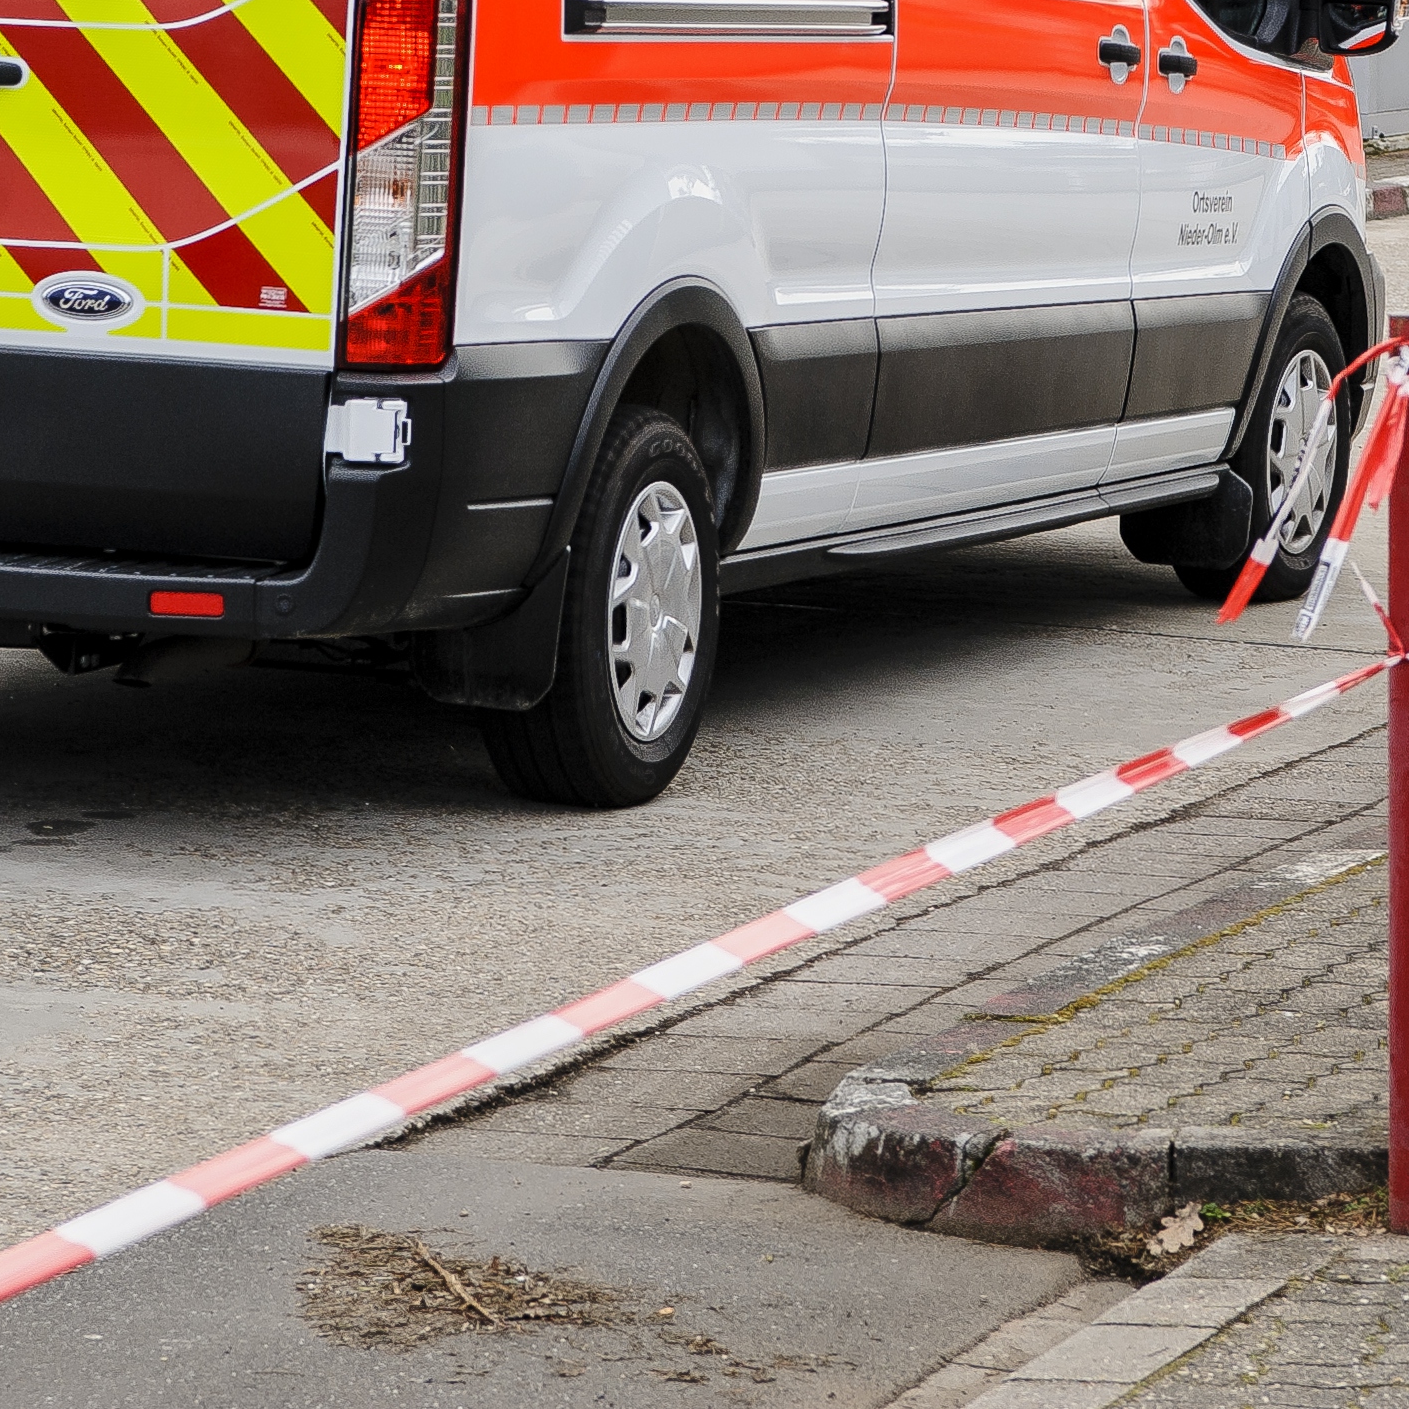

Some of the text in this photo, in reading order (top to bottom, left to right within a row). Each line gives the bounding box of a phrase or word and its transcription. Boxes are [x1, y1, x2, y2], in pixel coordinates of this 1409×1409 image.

[1192, 190, 1233, 213] Ortsverein
[1177, 223, 1223, 246] Nieder-Olm
[59, 287, 109, 311] Ford
